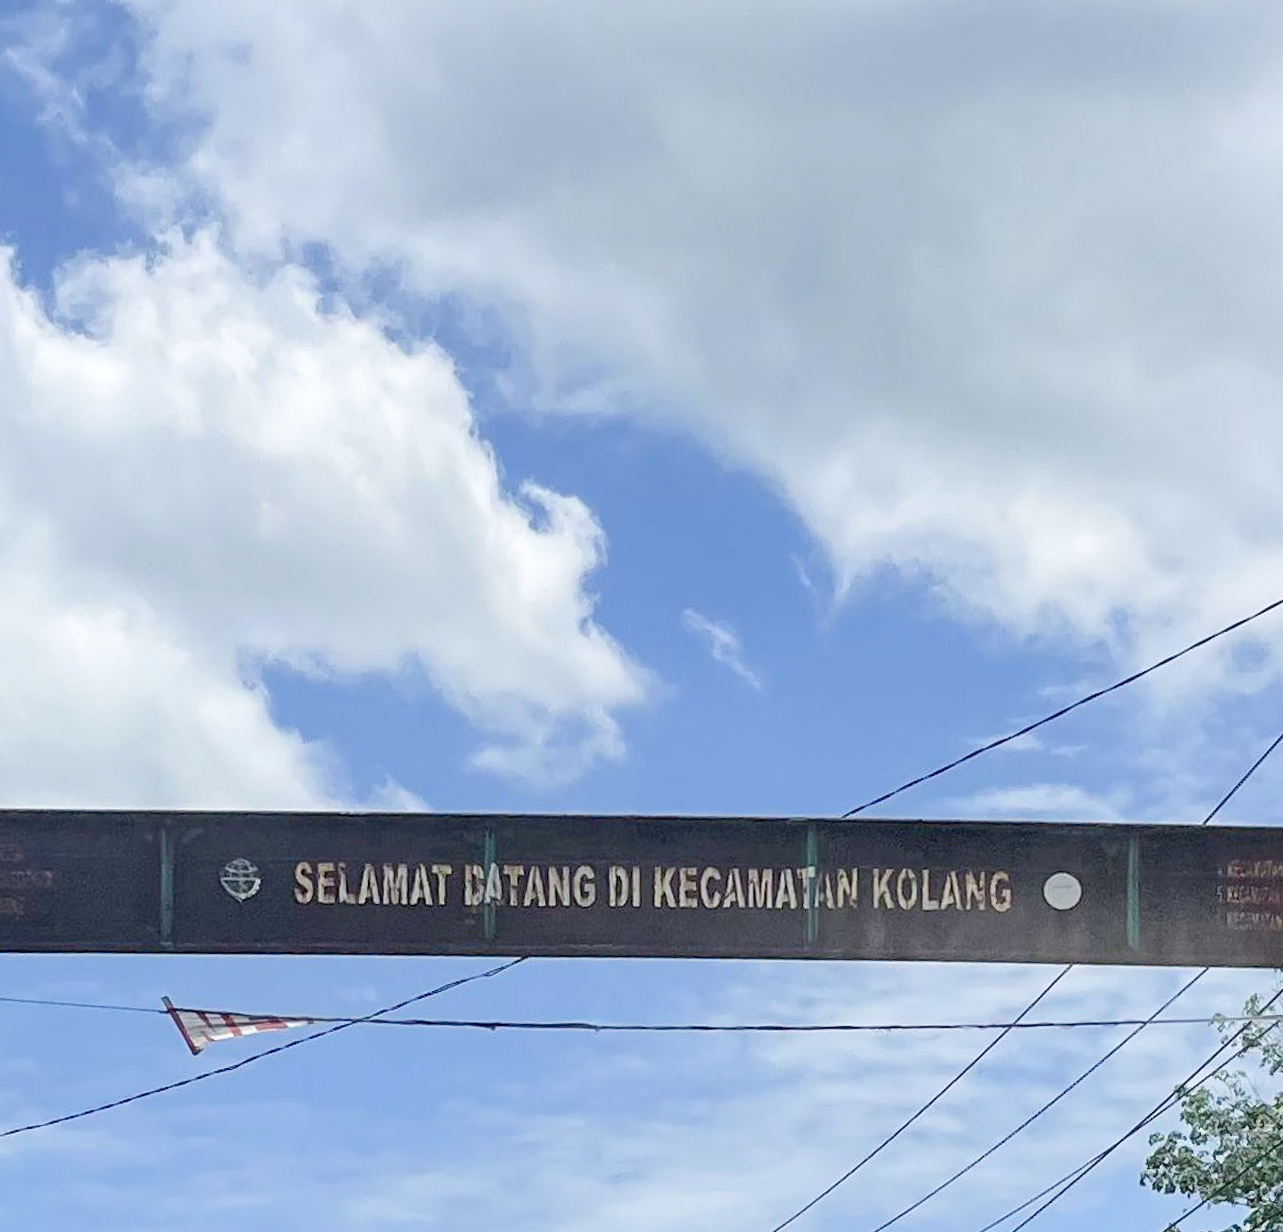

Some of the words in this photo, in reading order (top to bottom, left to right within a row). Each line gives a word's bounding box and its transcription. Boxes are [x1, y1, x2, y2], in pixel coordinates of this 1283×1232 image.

[294, 861, 453, 906] SELAMAT
[464, 863, 597, 908] DATANG
[608, 865, 642, 908] DI
[653, 866, 858, 911] KECAMATAN
[873, 868, 1013, 912] KOLANG
